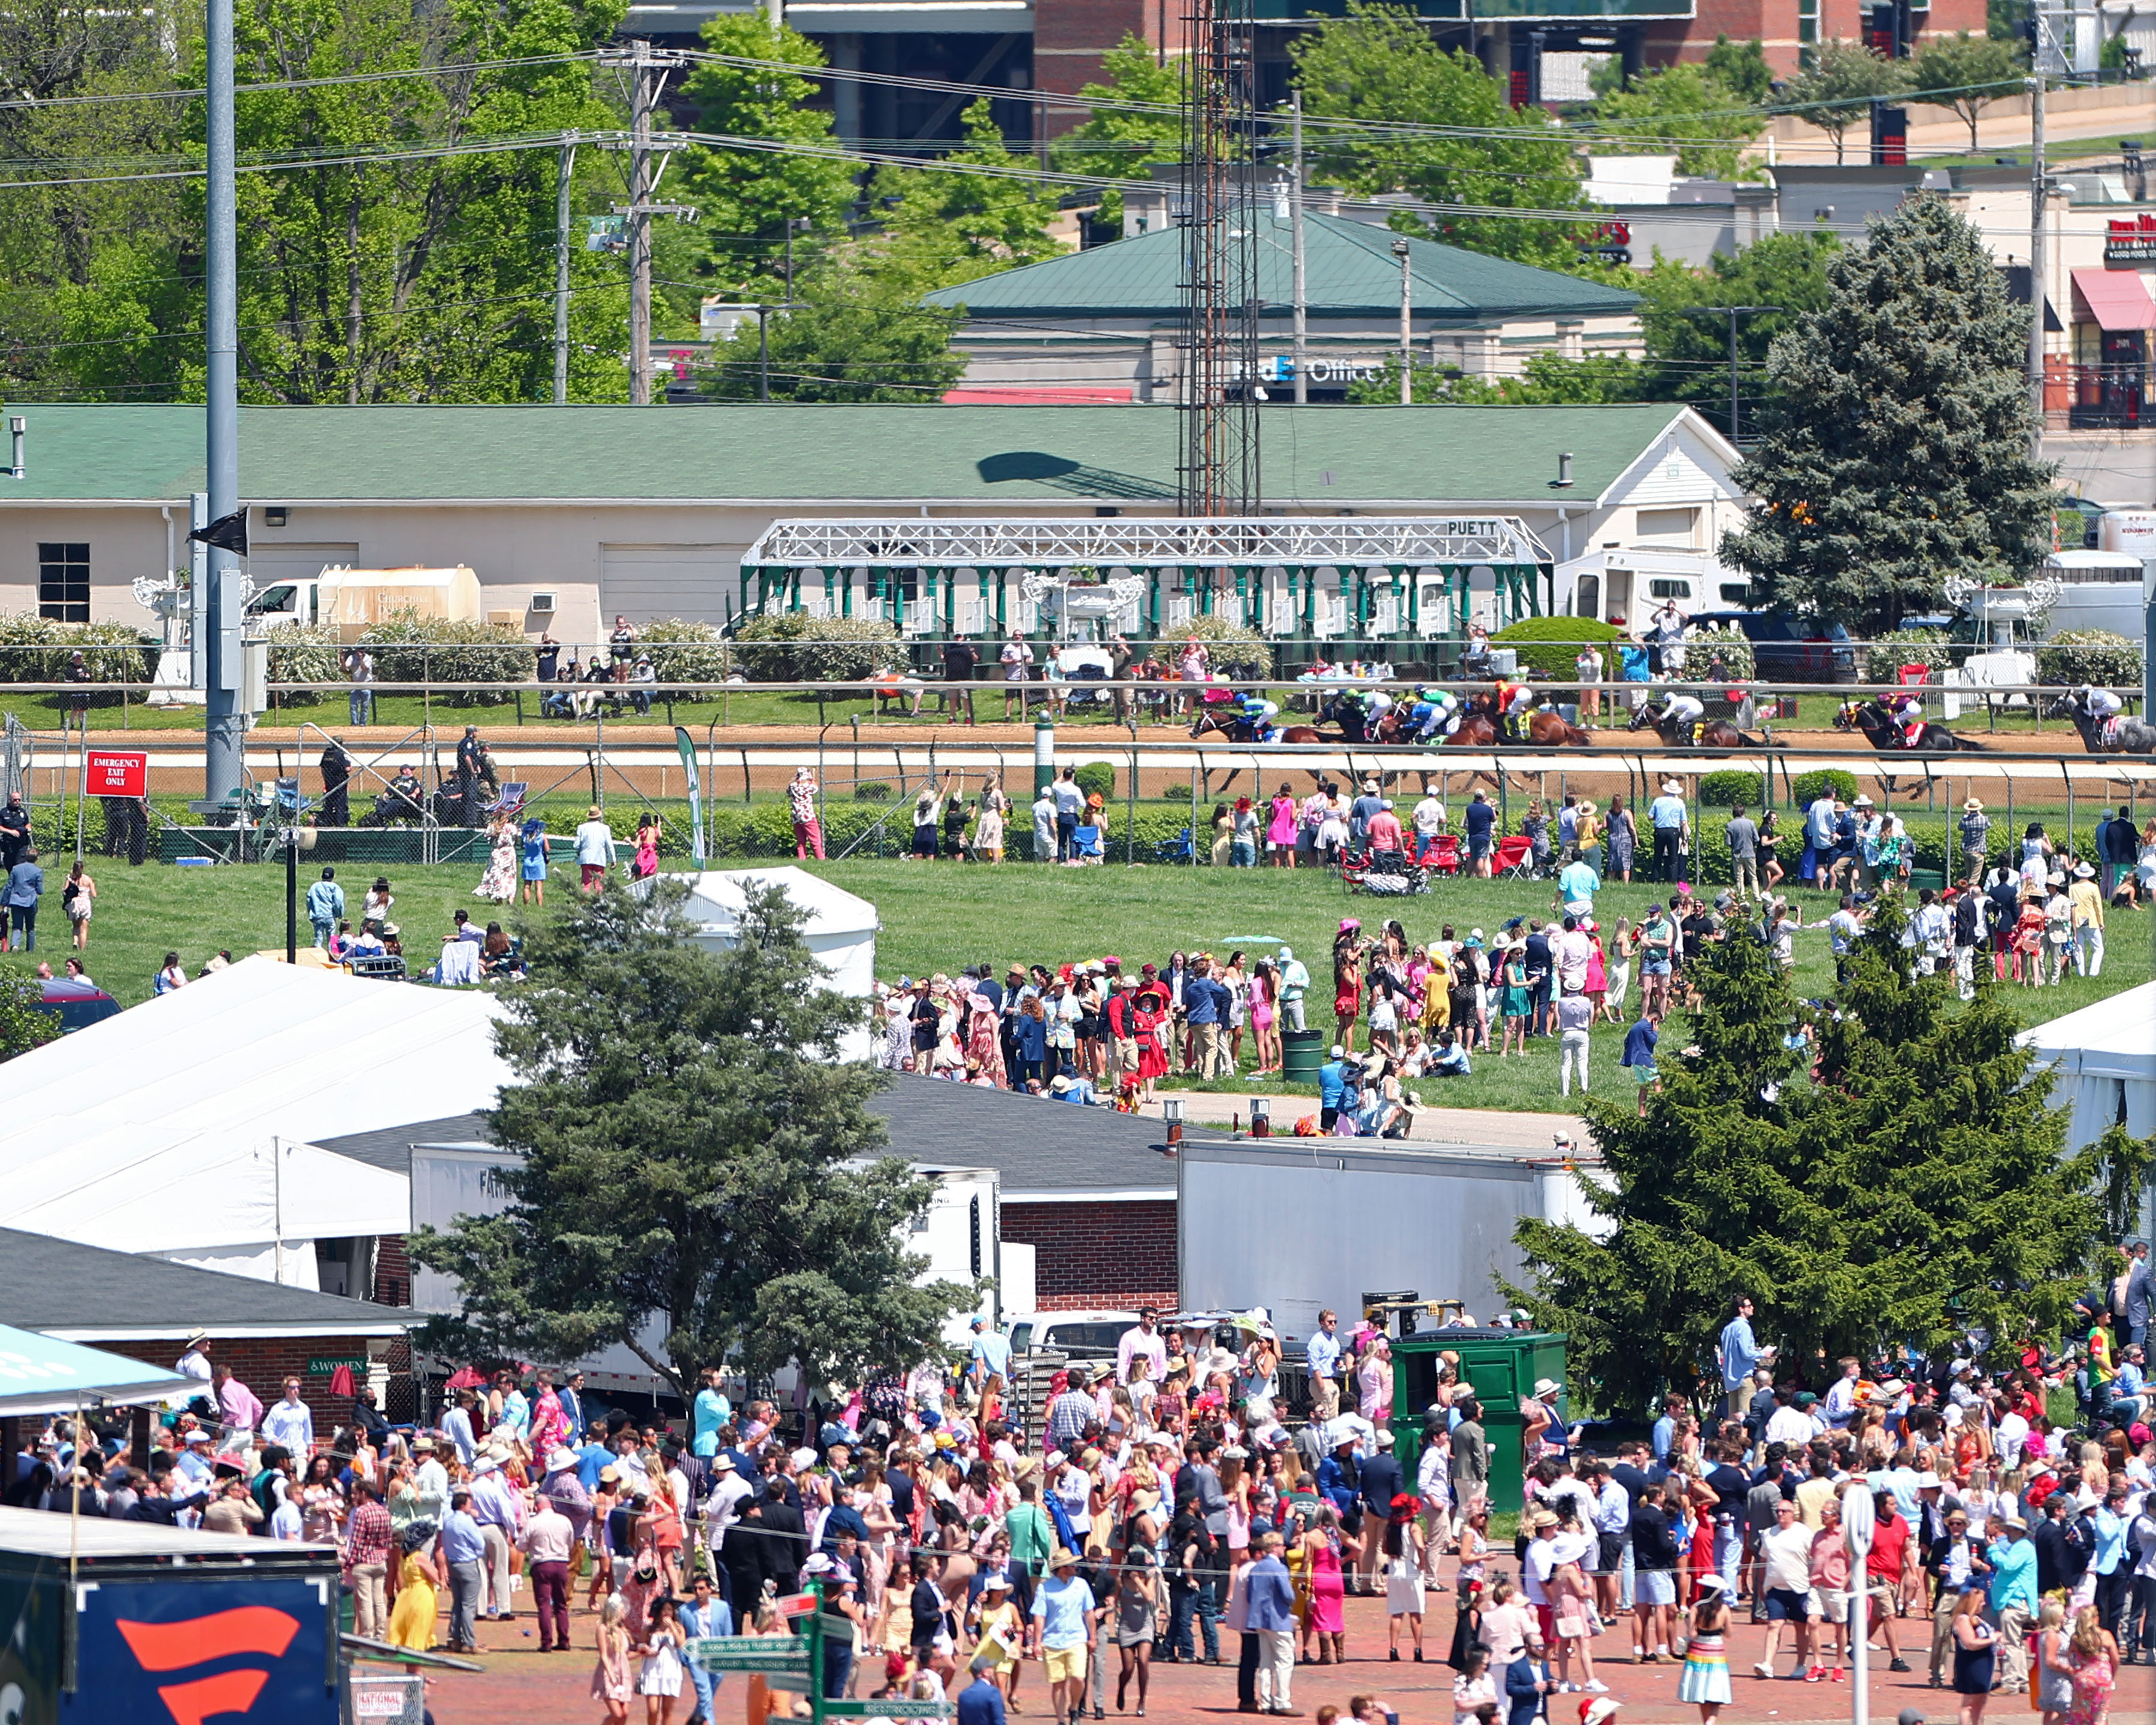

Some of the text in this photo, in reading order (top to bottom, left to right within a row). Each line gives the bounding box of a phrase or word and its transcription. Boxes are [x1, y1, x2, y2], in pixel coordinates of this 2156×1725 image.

[1448, 521, 1497, 535] PUETT
[93, 758, 140, 768] EMERGENCY
[107, 768, 125, 777] EXIT
[105, 777, 126, 786] ONLY
